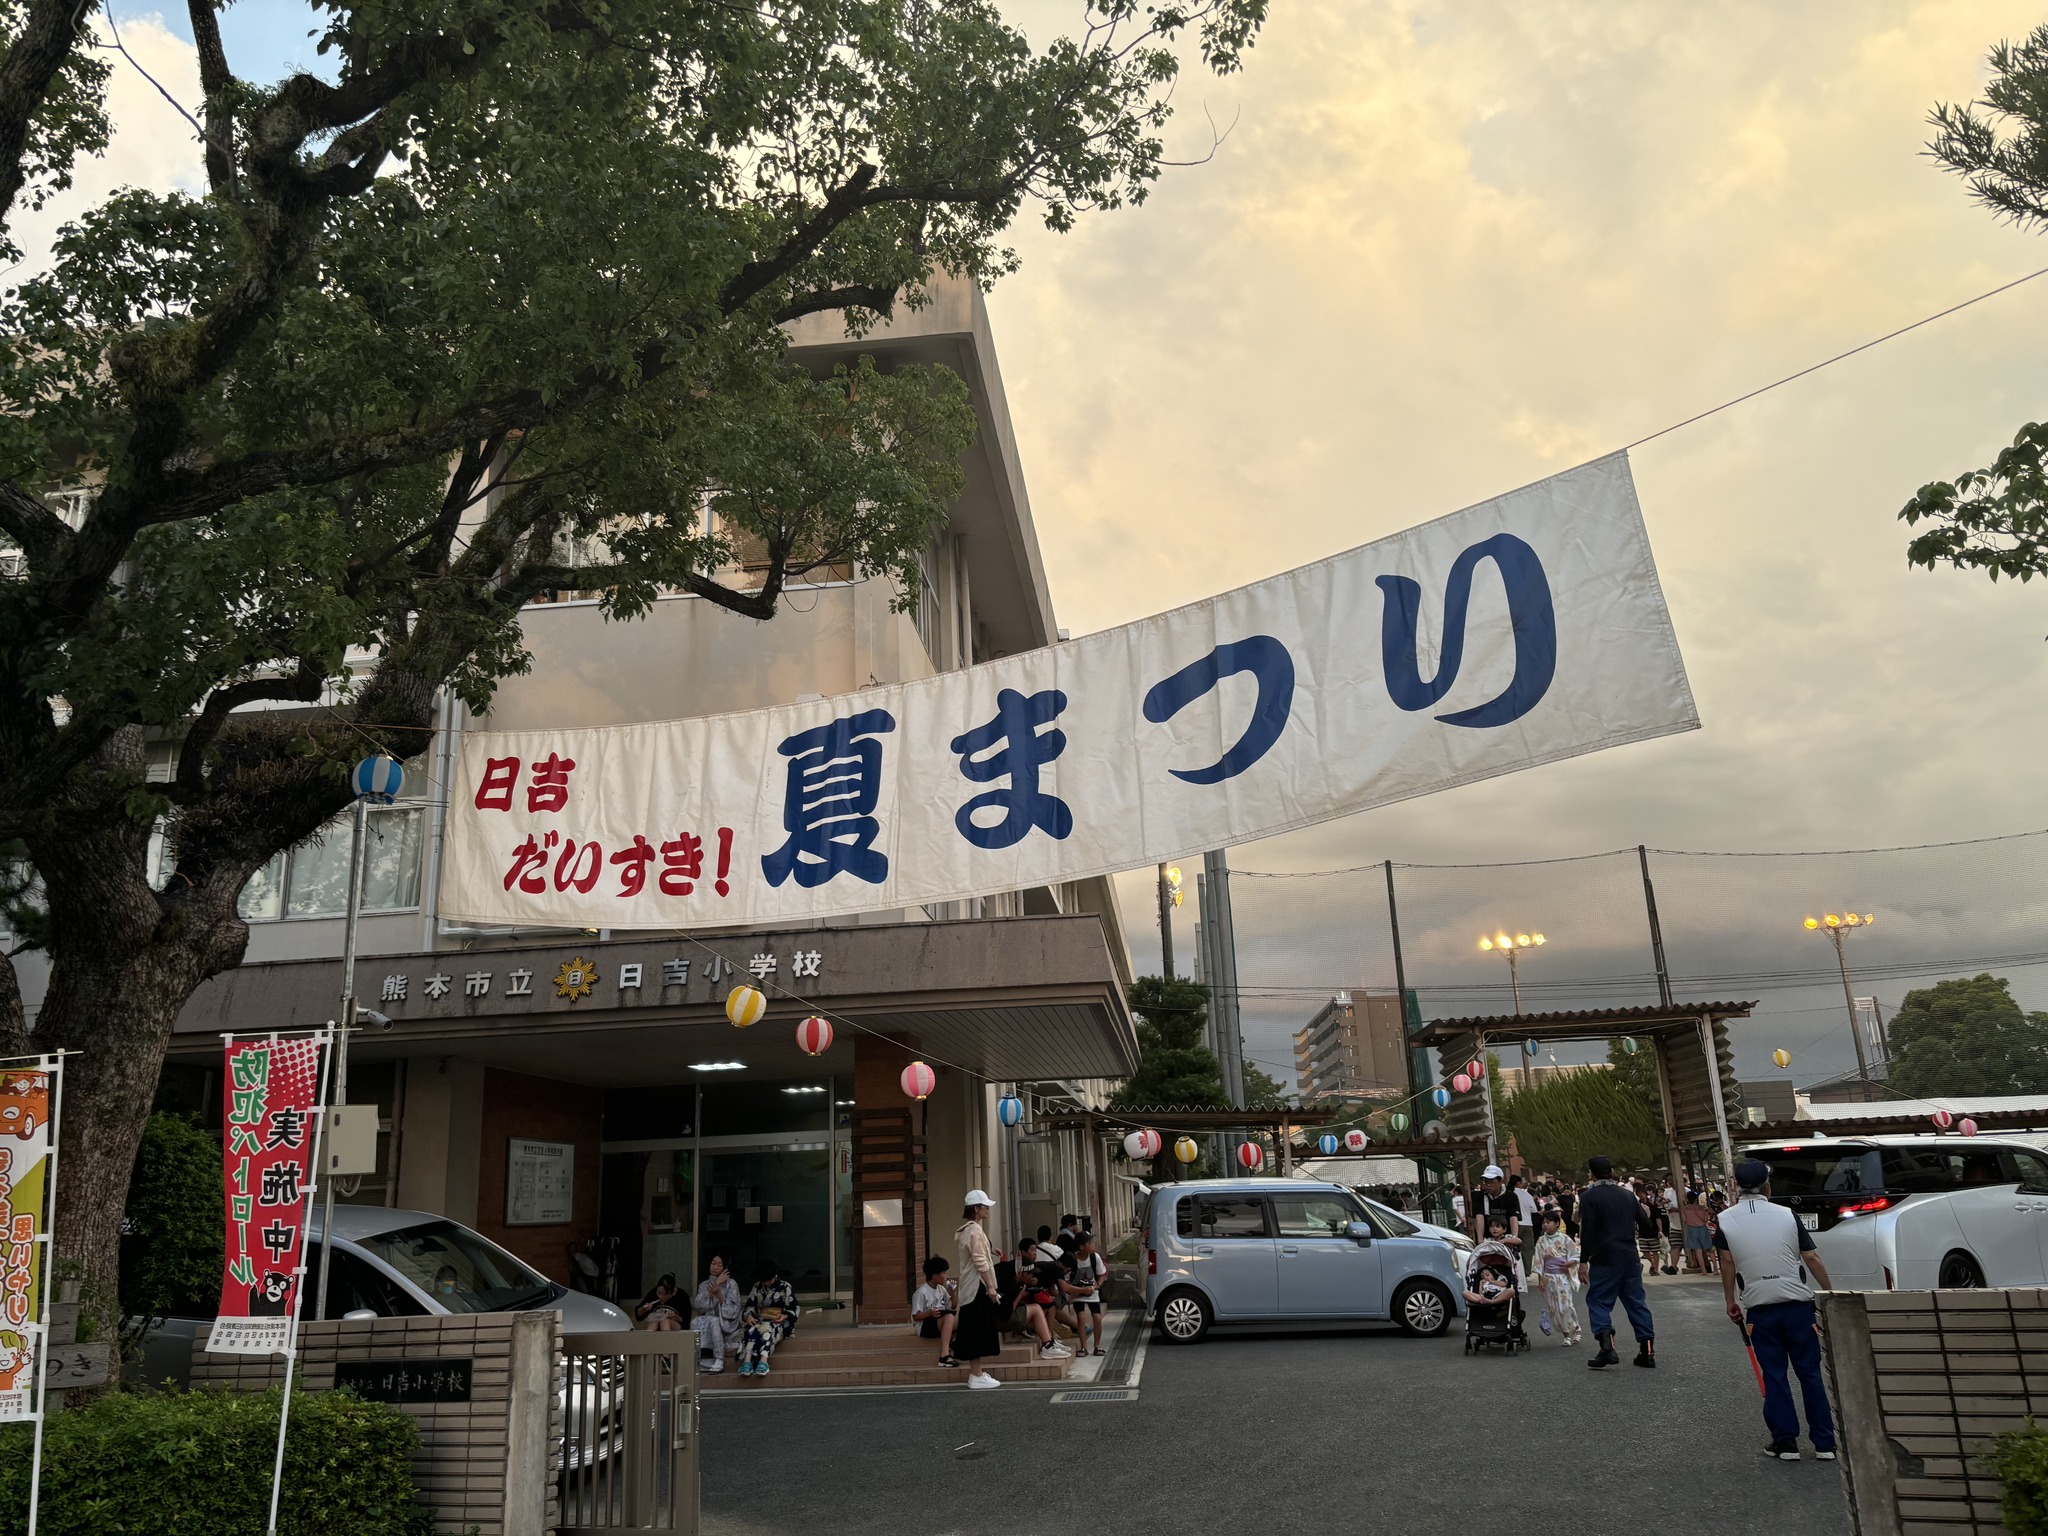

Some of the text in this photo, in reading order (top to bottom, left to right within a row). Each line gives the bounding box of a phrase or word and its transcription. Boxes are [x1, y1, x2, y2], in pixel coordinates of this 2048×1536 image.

[761, 533, 1557, 888] 夏まつり
[475, 752, 576, 813] 日吉
[381, 950, 822, 1001] 熊本市立 日吉小学校
